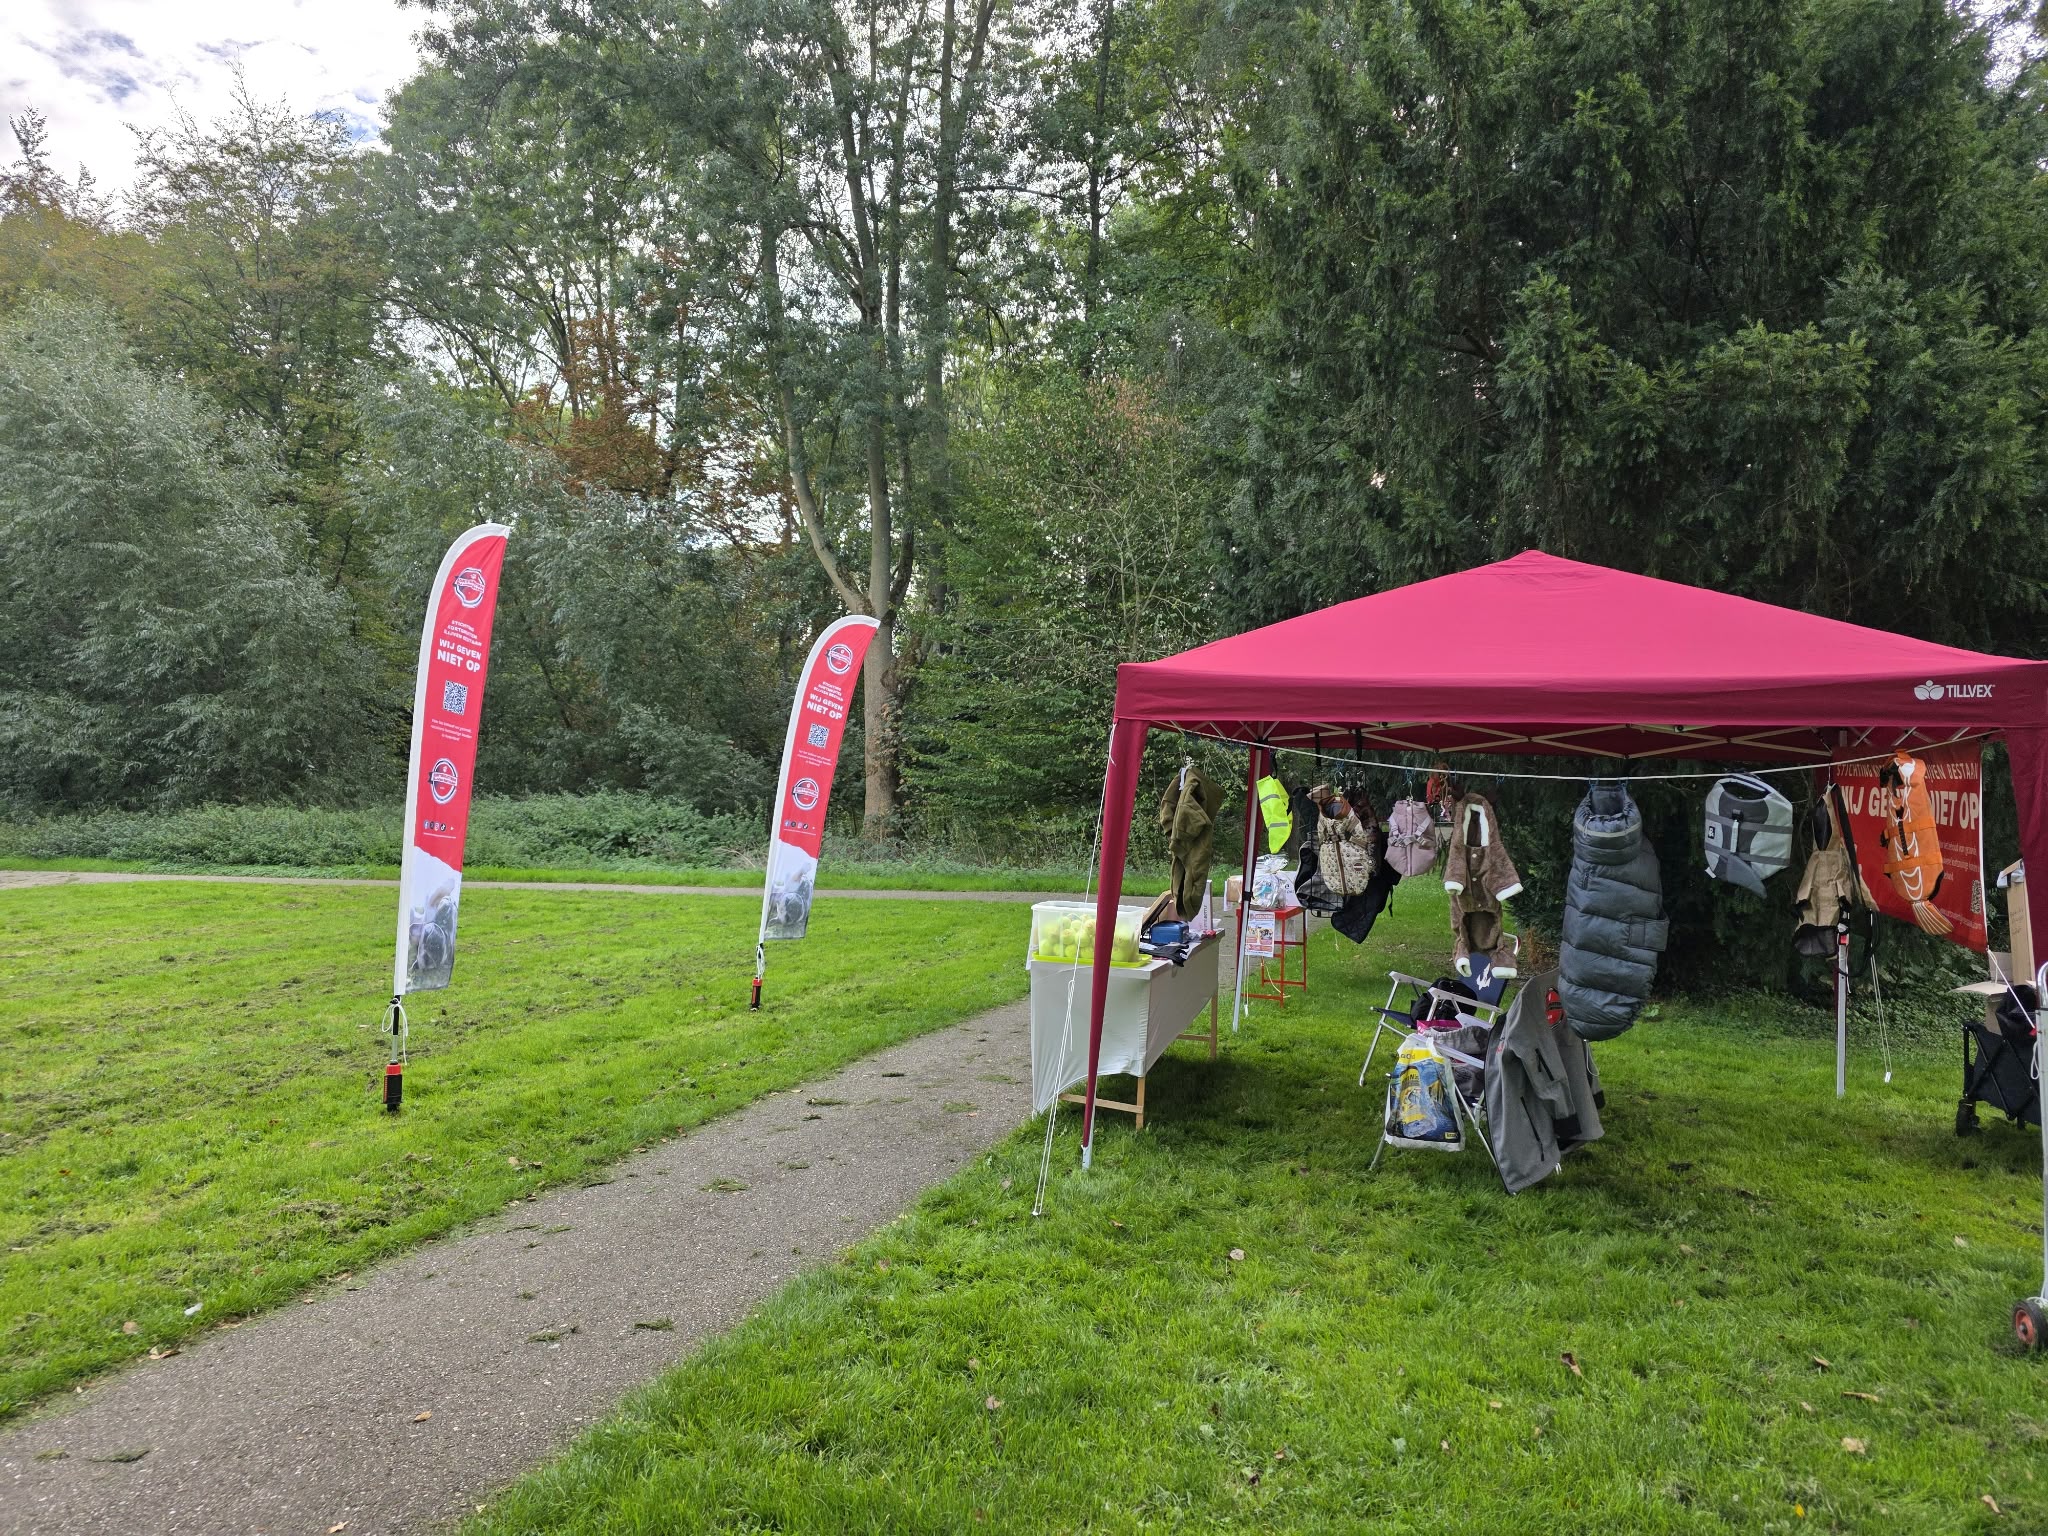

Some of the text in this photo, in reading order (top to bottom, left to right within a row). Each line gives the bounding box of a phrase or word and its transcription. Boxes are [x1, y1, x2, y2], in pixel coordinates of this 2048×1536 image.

[439, 638, 482, 660] WIJ GEVEN
[437, 649, 481, 672] NIET OP
[1946, 684, 1993, 698] TILLVEX
[807, 701, 843, 720] NIET OP
[810, 693, 822, 703] WIJ
[822, 699, 844, 711] GEVEN
[1959, 791, 1979, 830] OP
